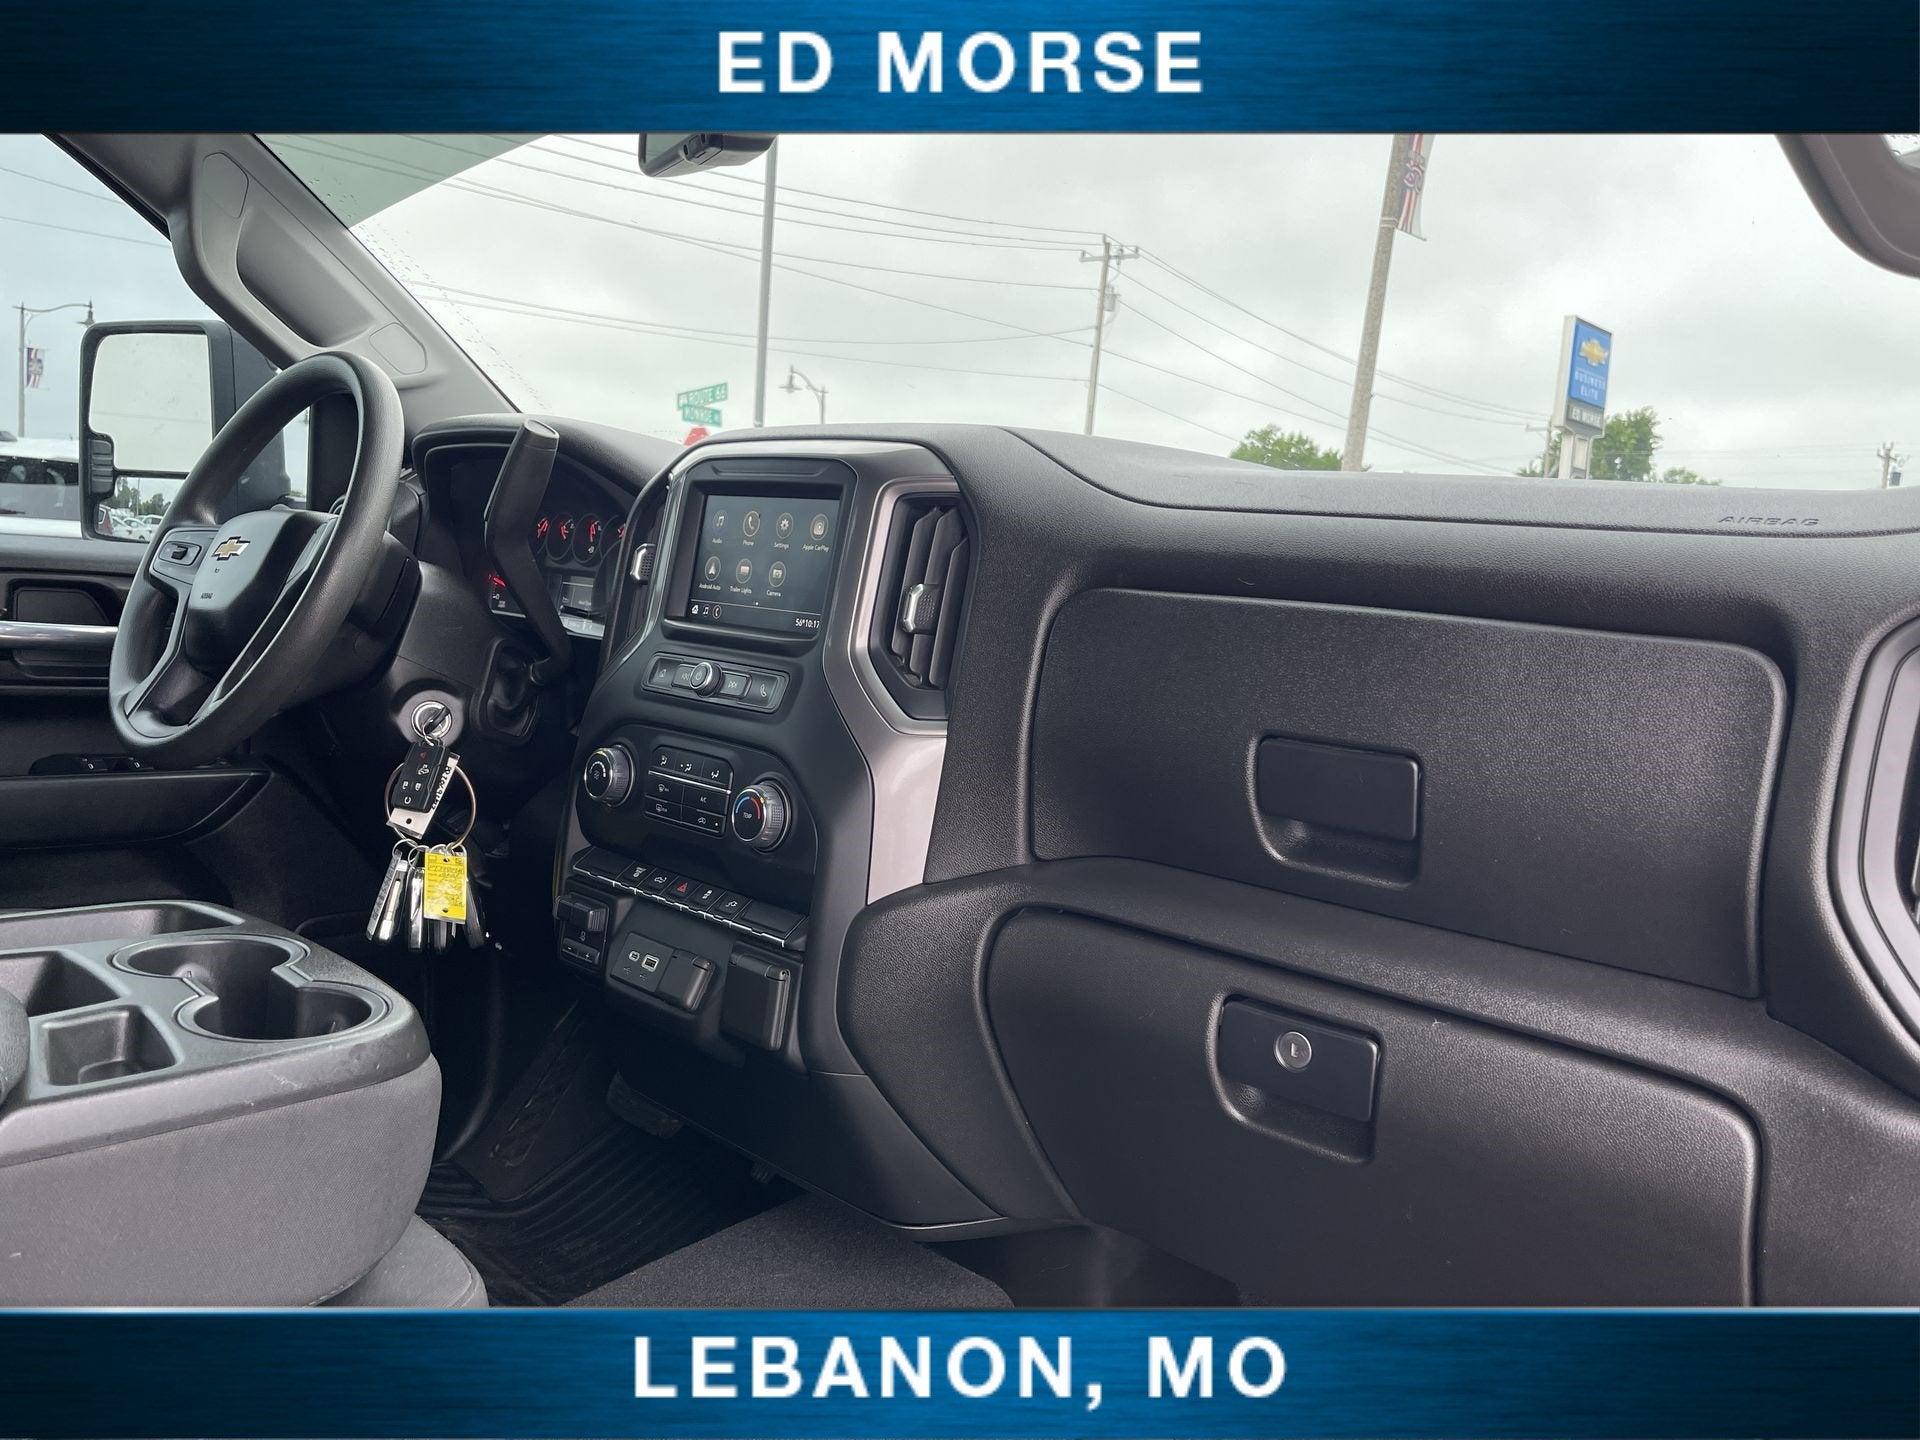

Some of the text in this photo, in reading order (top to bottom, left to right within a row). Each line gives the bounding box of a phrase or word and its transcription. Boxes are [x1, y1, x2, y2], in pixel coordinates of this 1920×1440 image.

[1718, 516, 1820, 526] AIRBAG
[742, 539, 755, 547] Phone
[773, 541, 790, 550] Settings
[801, 543, 814, 552] Apple
[766, 589, 782, 598] Camera
